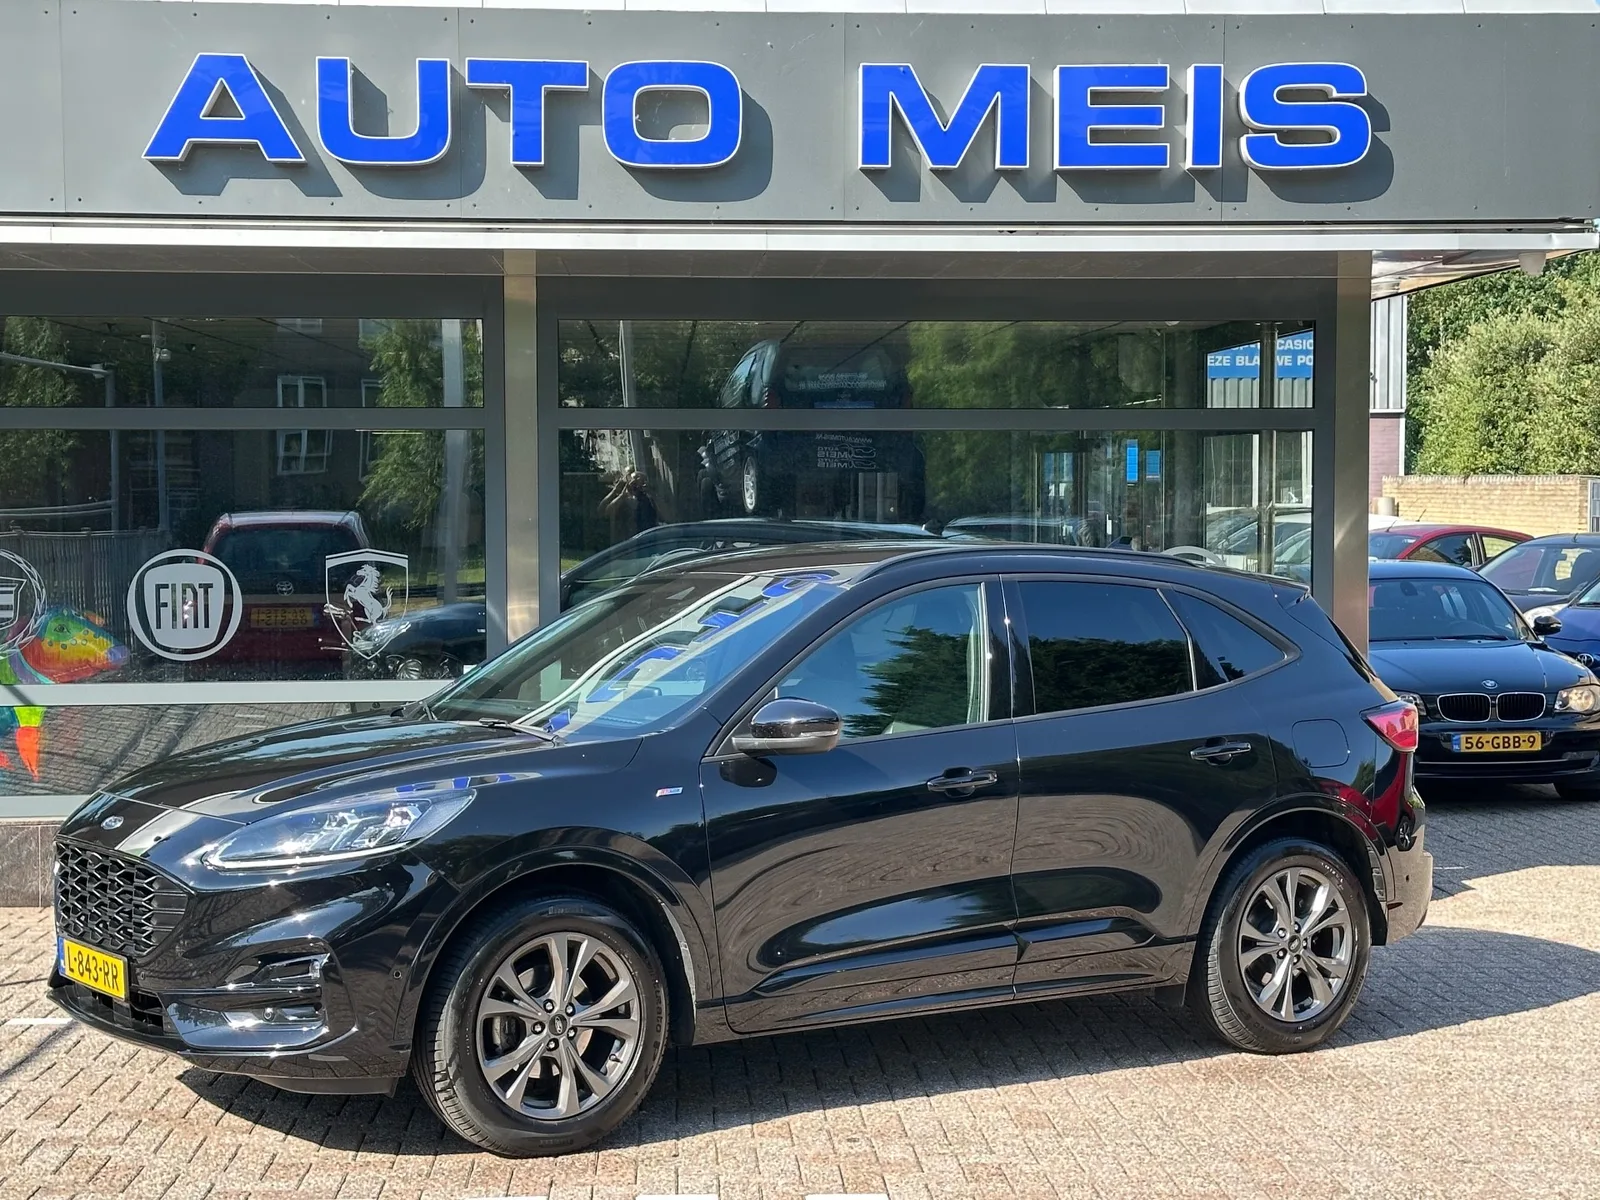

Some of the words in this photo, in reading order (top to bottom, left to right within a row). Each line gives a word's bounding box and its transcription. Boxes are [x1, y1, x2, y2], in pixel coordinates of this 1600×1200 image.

[142, 53, 742, 168] AUTO
[858, 62, 1373, 170] MEIS
[155, 583, 214, 629] FIAT
[1464, 735, 1536, 750] 56-GBB-9
[67, 945, 119, 992] L-843-RR
